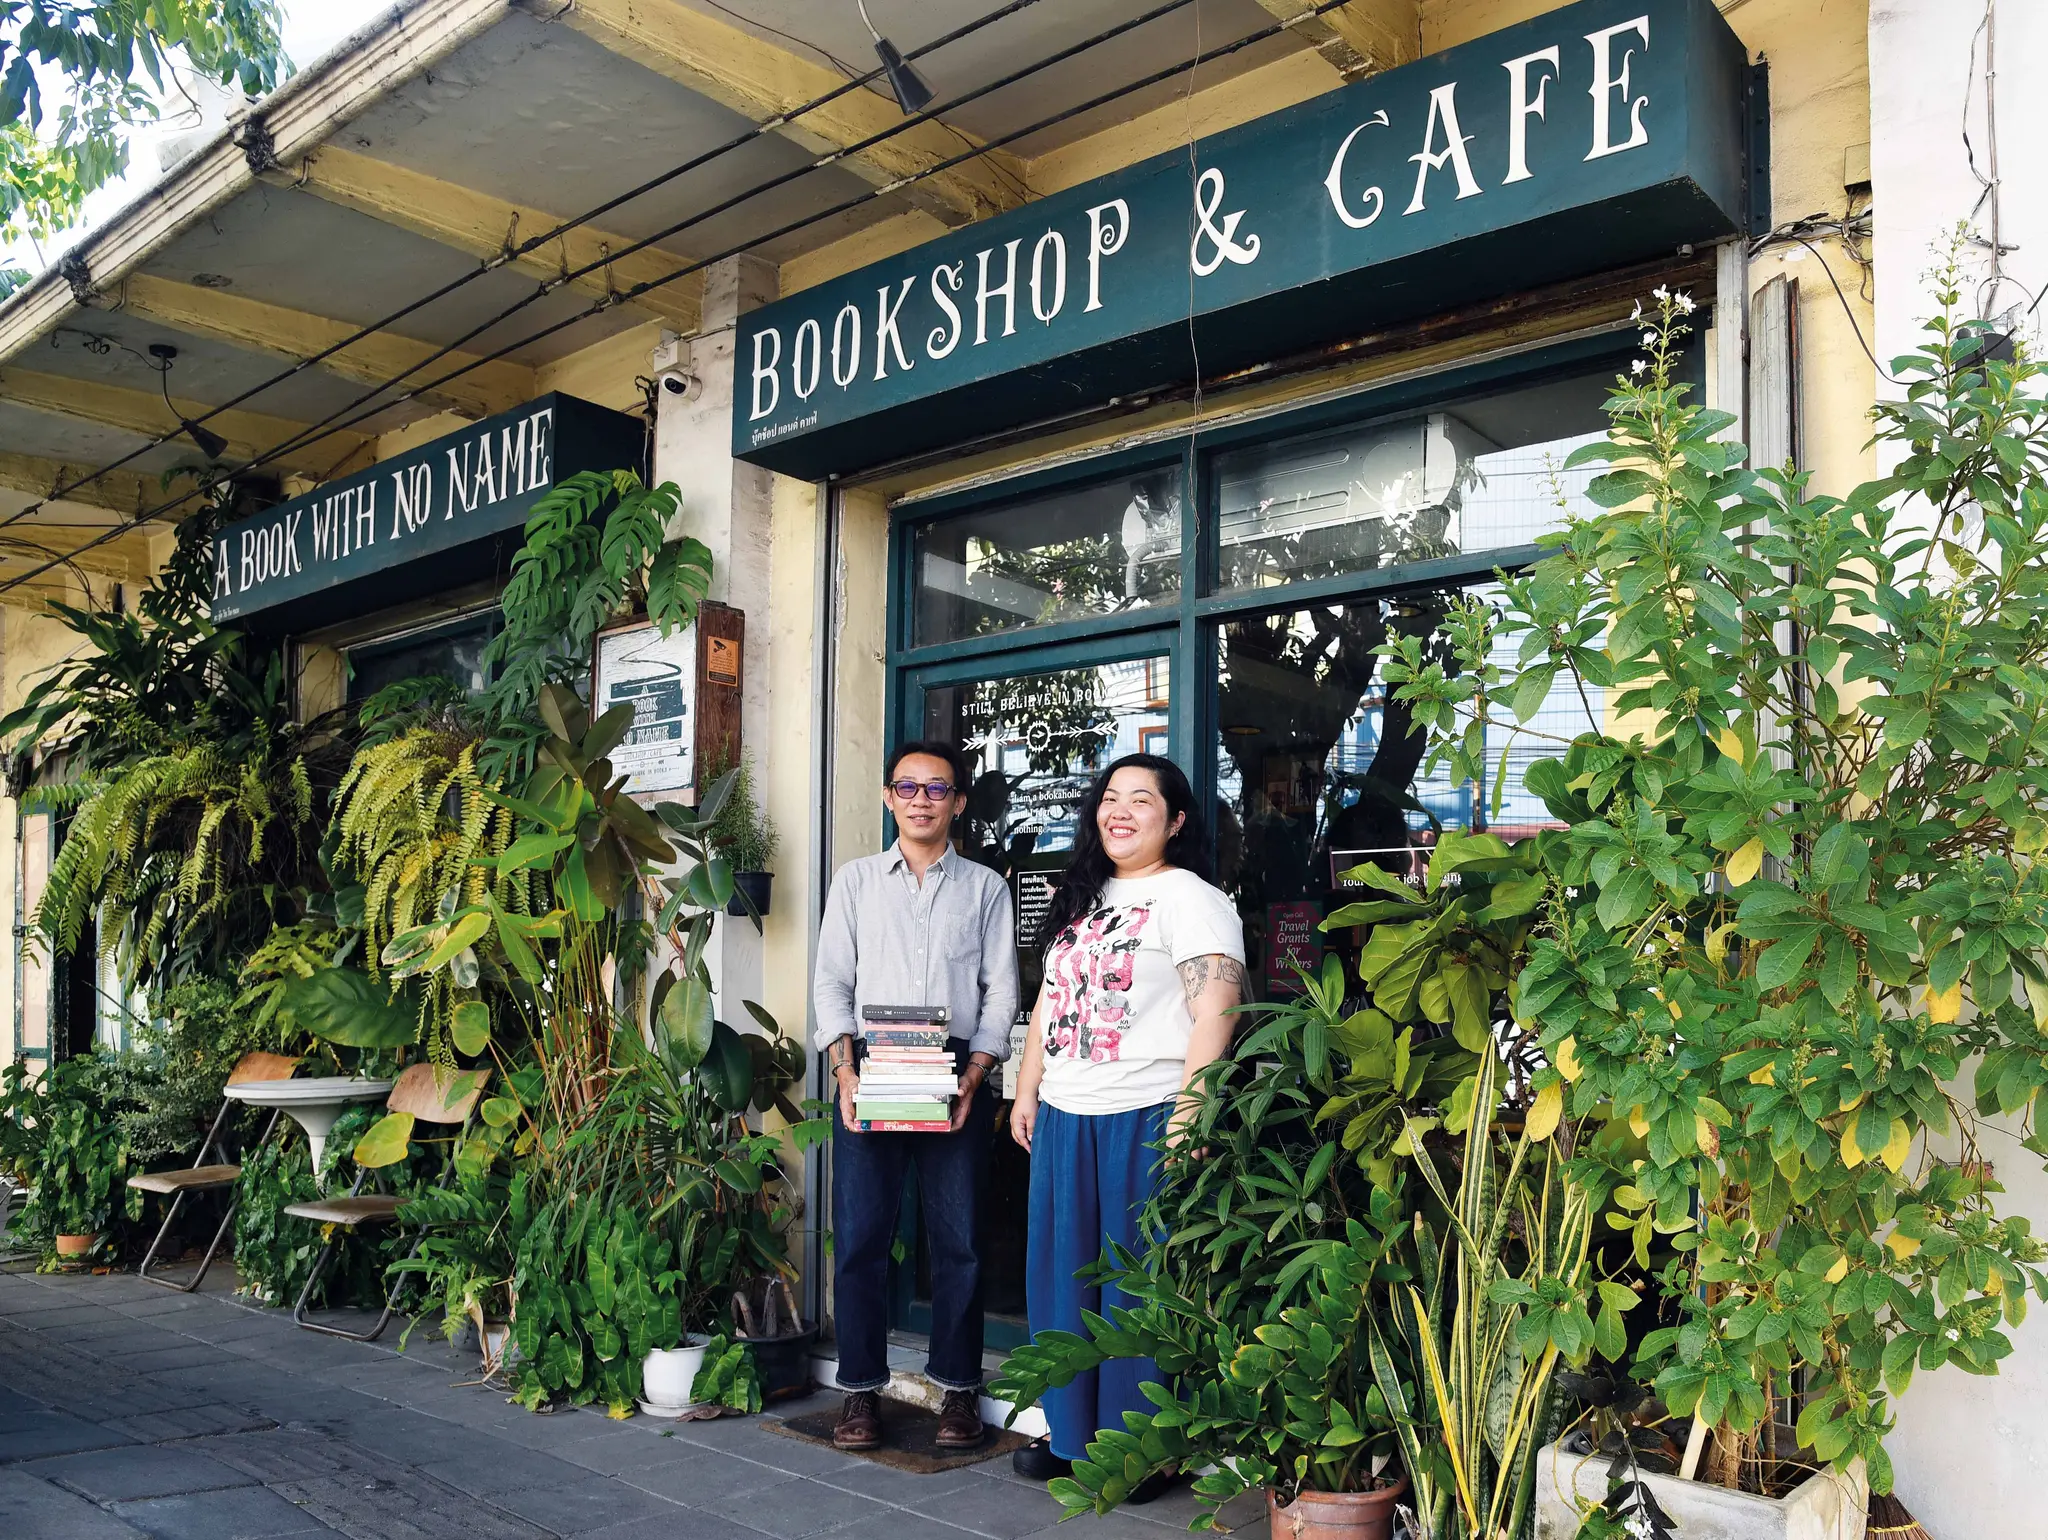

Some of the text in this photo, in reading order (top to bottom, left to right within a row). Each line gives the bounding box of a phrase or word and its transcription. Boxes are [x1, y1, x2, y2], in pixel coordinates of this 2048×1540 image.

[749, 15, 1650, 422] BOOKSHOP & CAFE
[212, 407, 553, 601] A BOOK WITH NO NAME
[961, 700, 995, 717] STILL
[1000, 692, 1052, 712] BELIEVE
[1058, 690, 1071, 705] IN
[637, 725, 670, 745] NAME
[1039, 789, 1081, 801] bookaholic
[1403, 873, 1420, 885] job
[1278, 920, 1309, 931] Travel
[1277, 933, 1311, 944] Grants
[1285, 944, 1301, 958] for
